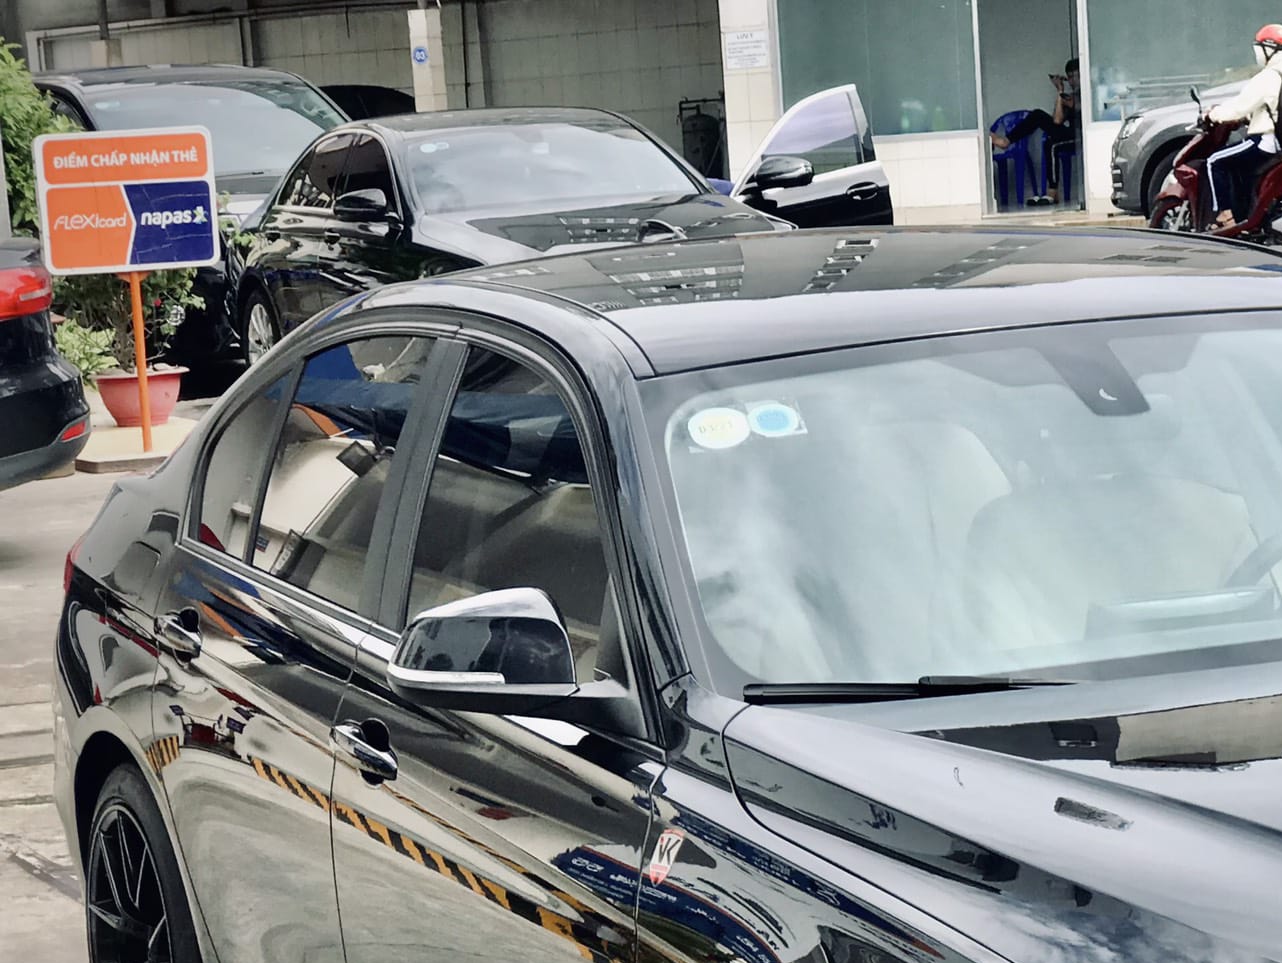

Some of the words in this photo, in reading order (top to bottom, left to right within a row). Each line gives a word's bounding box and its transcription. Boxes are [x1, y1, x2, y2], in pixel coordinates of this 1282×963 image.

[53, 151, 88, 169] ĐIỂM
[91, 150, 128, 167] CHẤP
[130, 148, 170, 168] NHẬN
[171, 146, 198, 163] THẺ
[140, 211, 192, 229] napas
